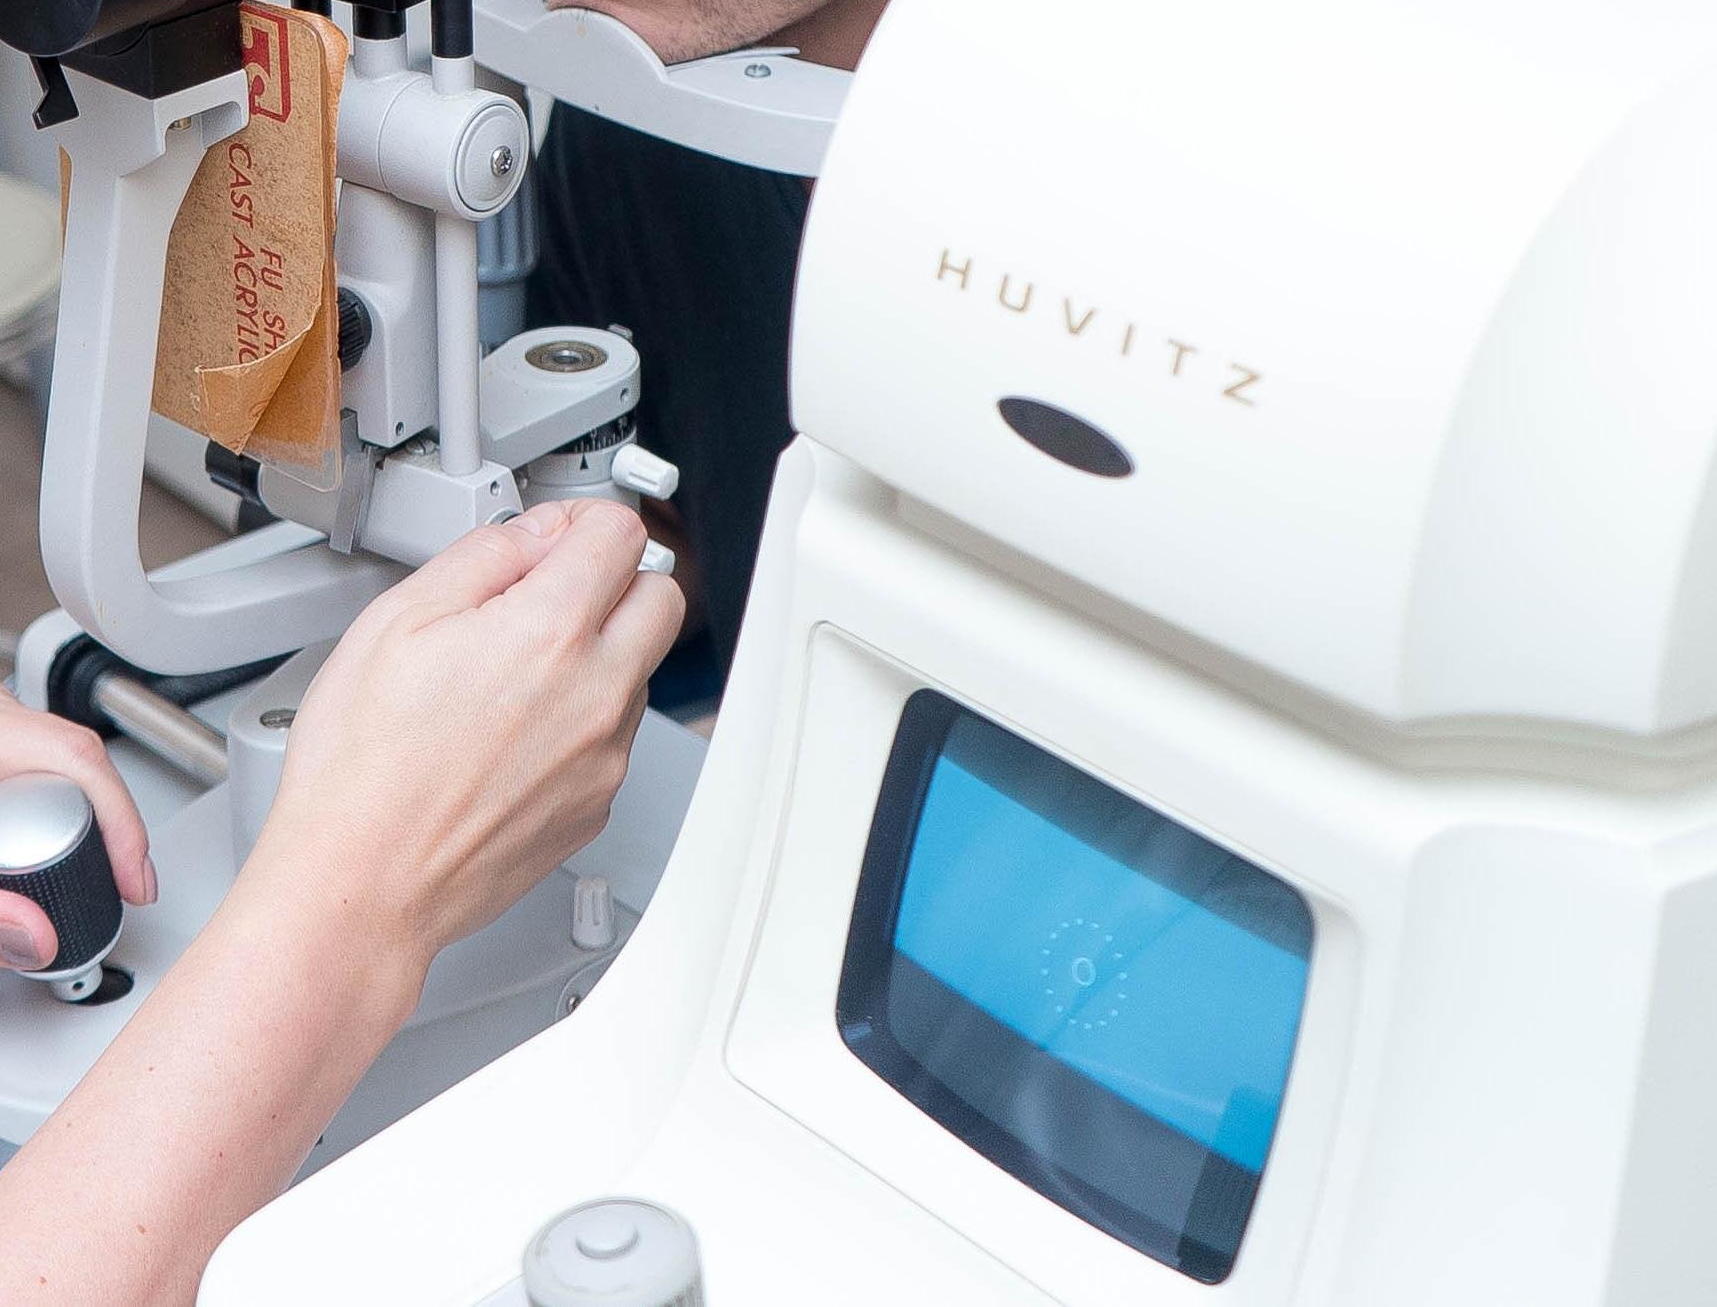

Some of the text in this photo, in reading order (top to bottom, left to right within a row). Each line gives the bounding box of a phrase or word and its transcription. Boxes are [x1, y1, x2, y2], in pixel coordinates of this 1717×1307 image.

[228, 142, 260, 365] CAST ACRYLIC
[260, 247, 285, 356] FU SH
[935, 247, 1262, 406] HUVITZ
